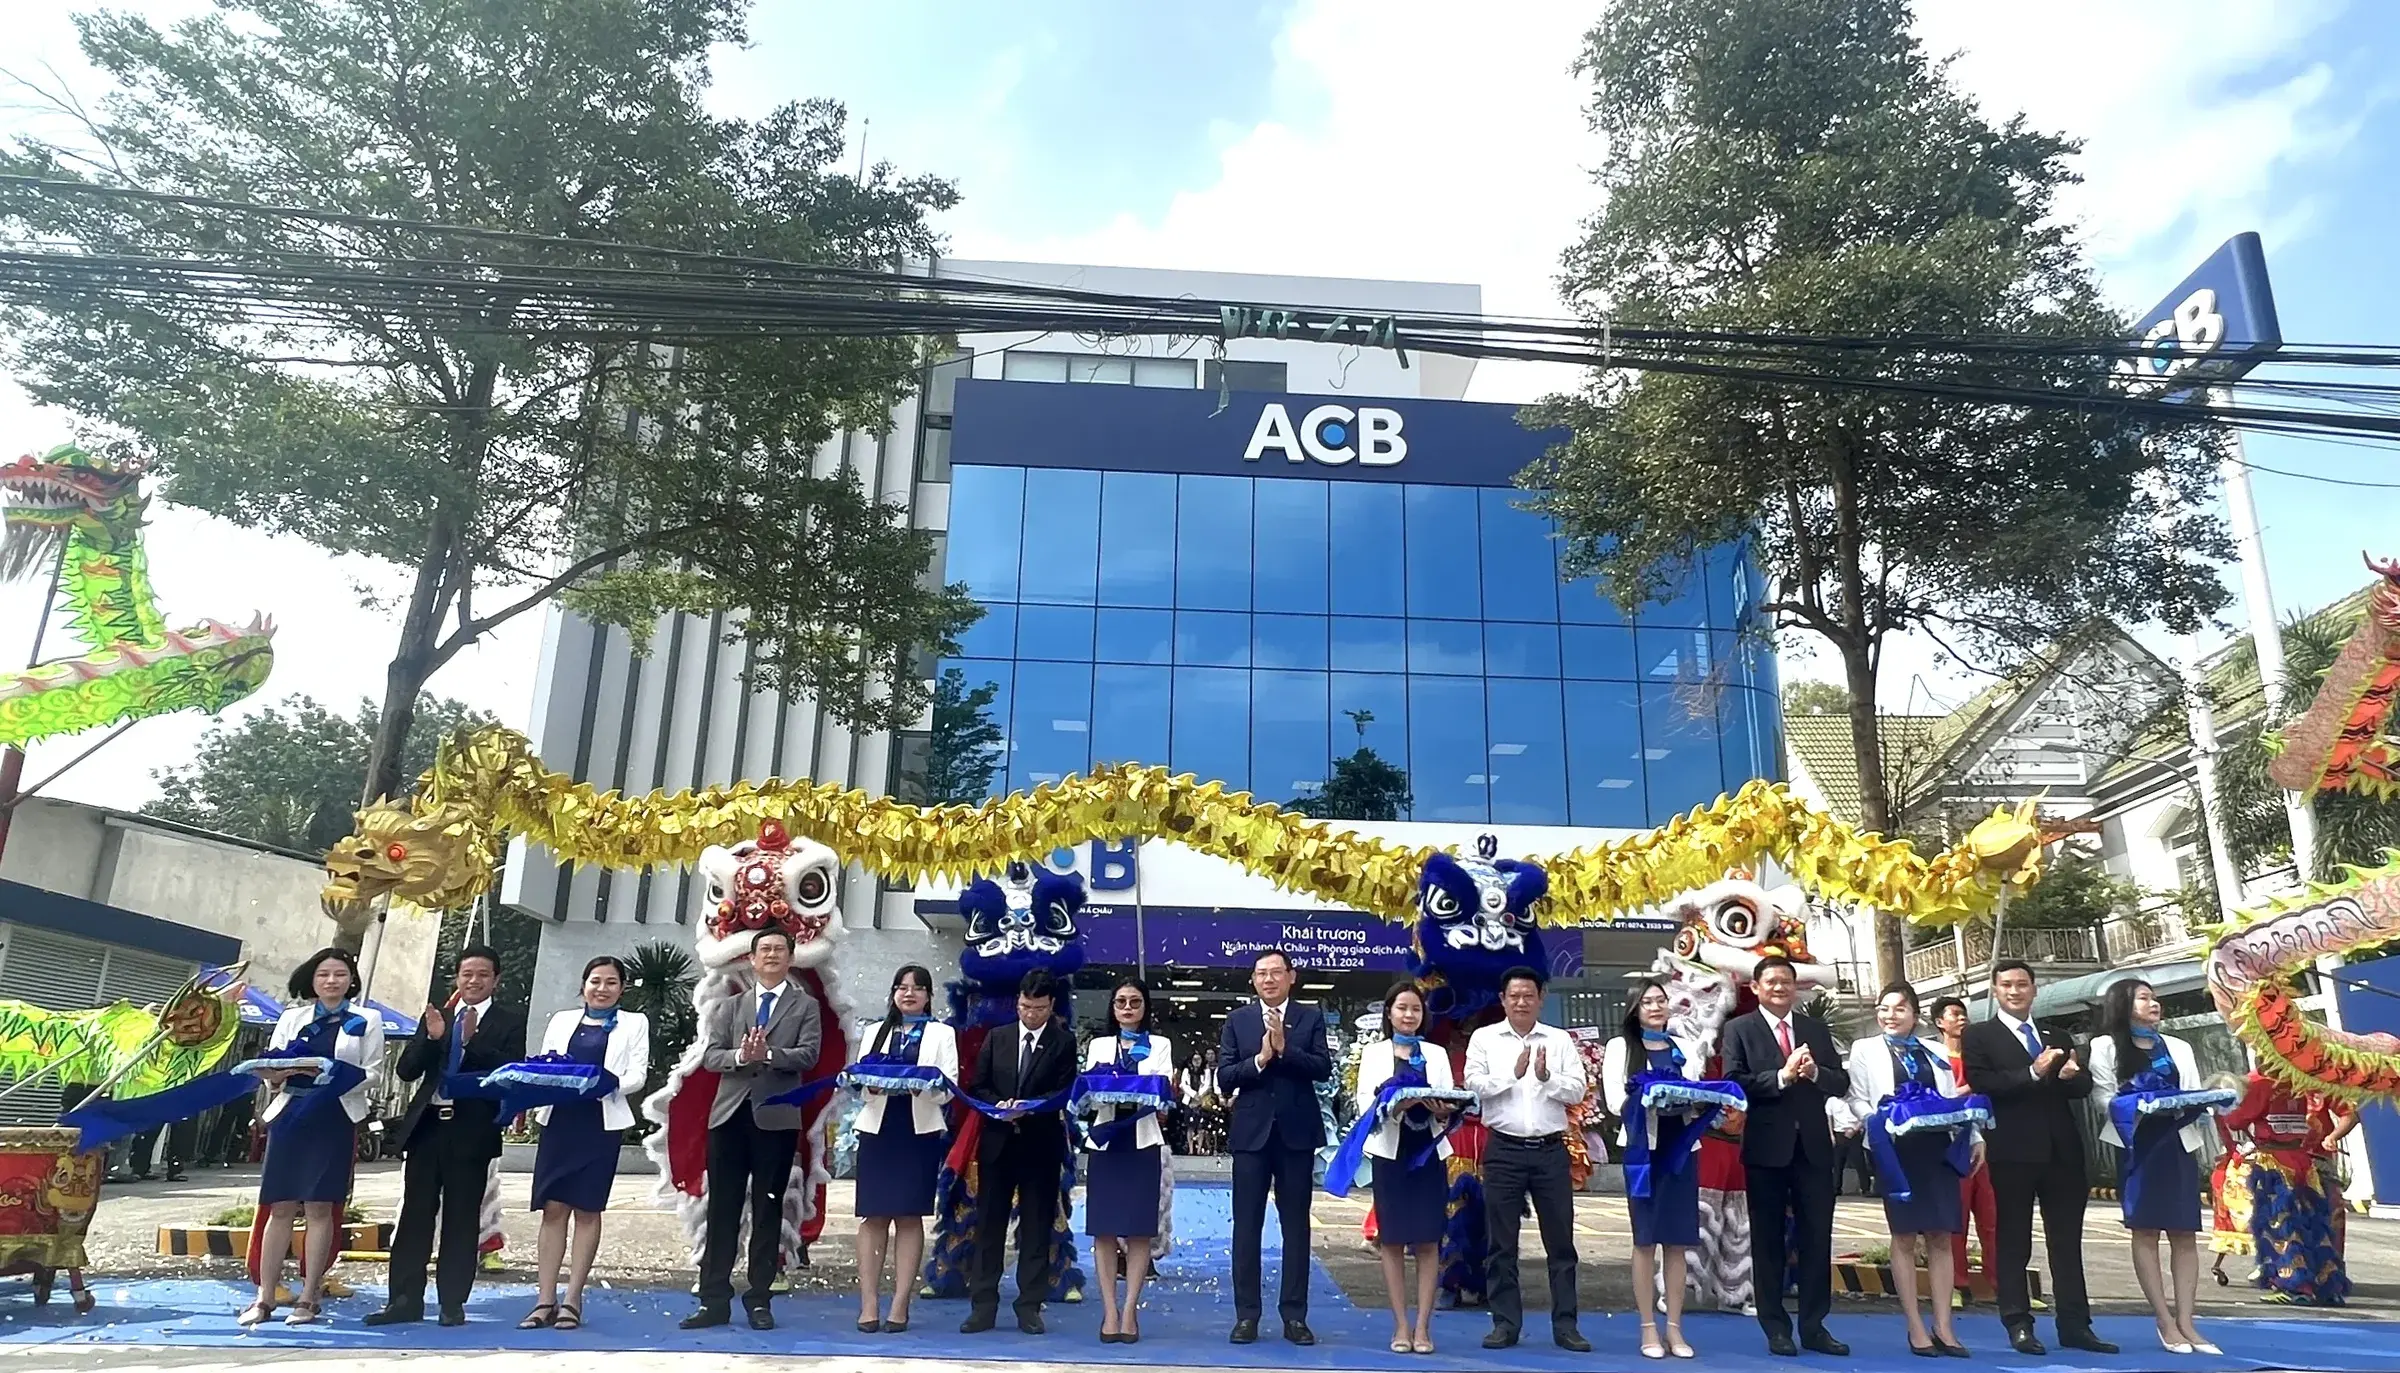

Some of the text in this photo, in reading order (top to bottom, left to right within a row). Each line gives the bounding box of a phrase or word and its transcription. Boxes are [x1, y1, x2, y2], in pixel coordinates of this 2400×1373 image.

[1243, 403, 1408, 466] ACB
[1316, 927, 1366, 944] trương
[1284, 942, 1309, 952] Châu
[1350, 945, 1370, 955] giao
[1372, 945, 1392, 956] dịch
[1290, 957, 1364, 968] gày 19.11.2024
